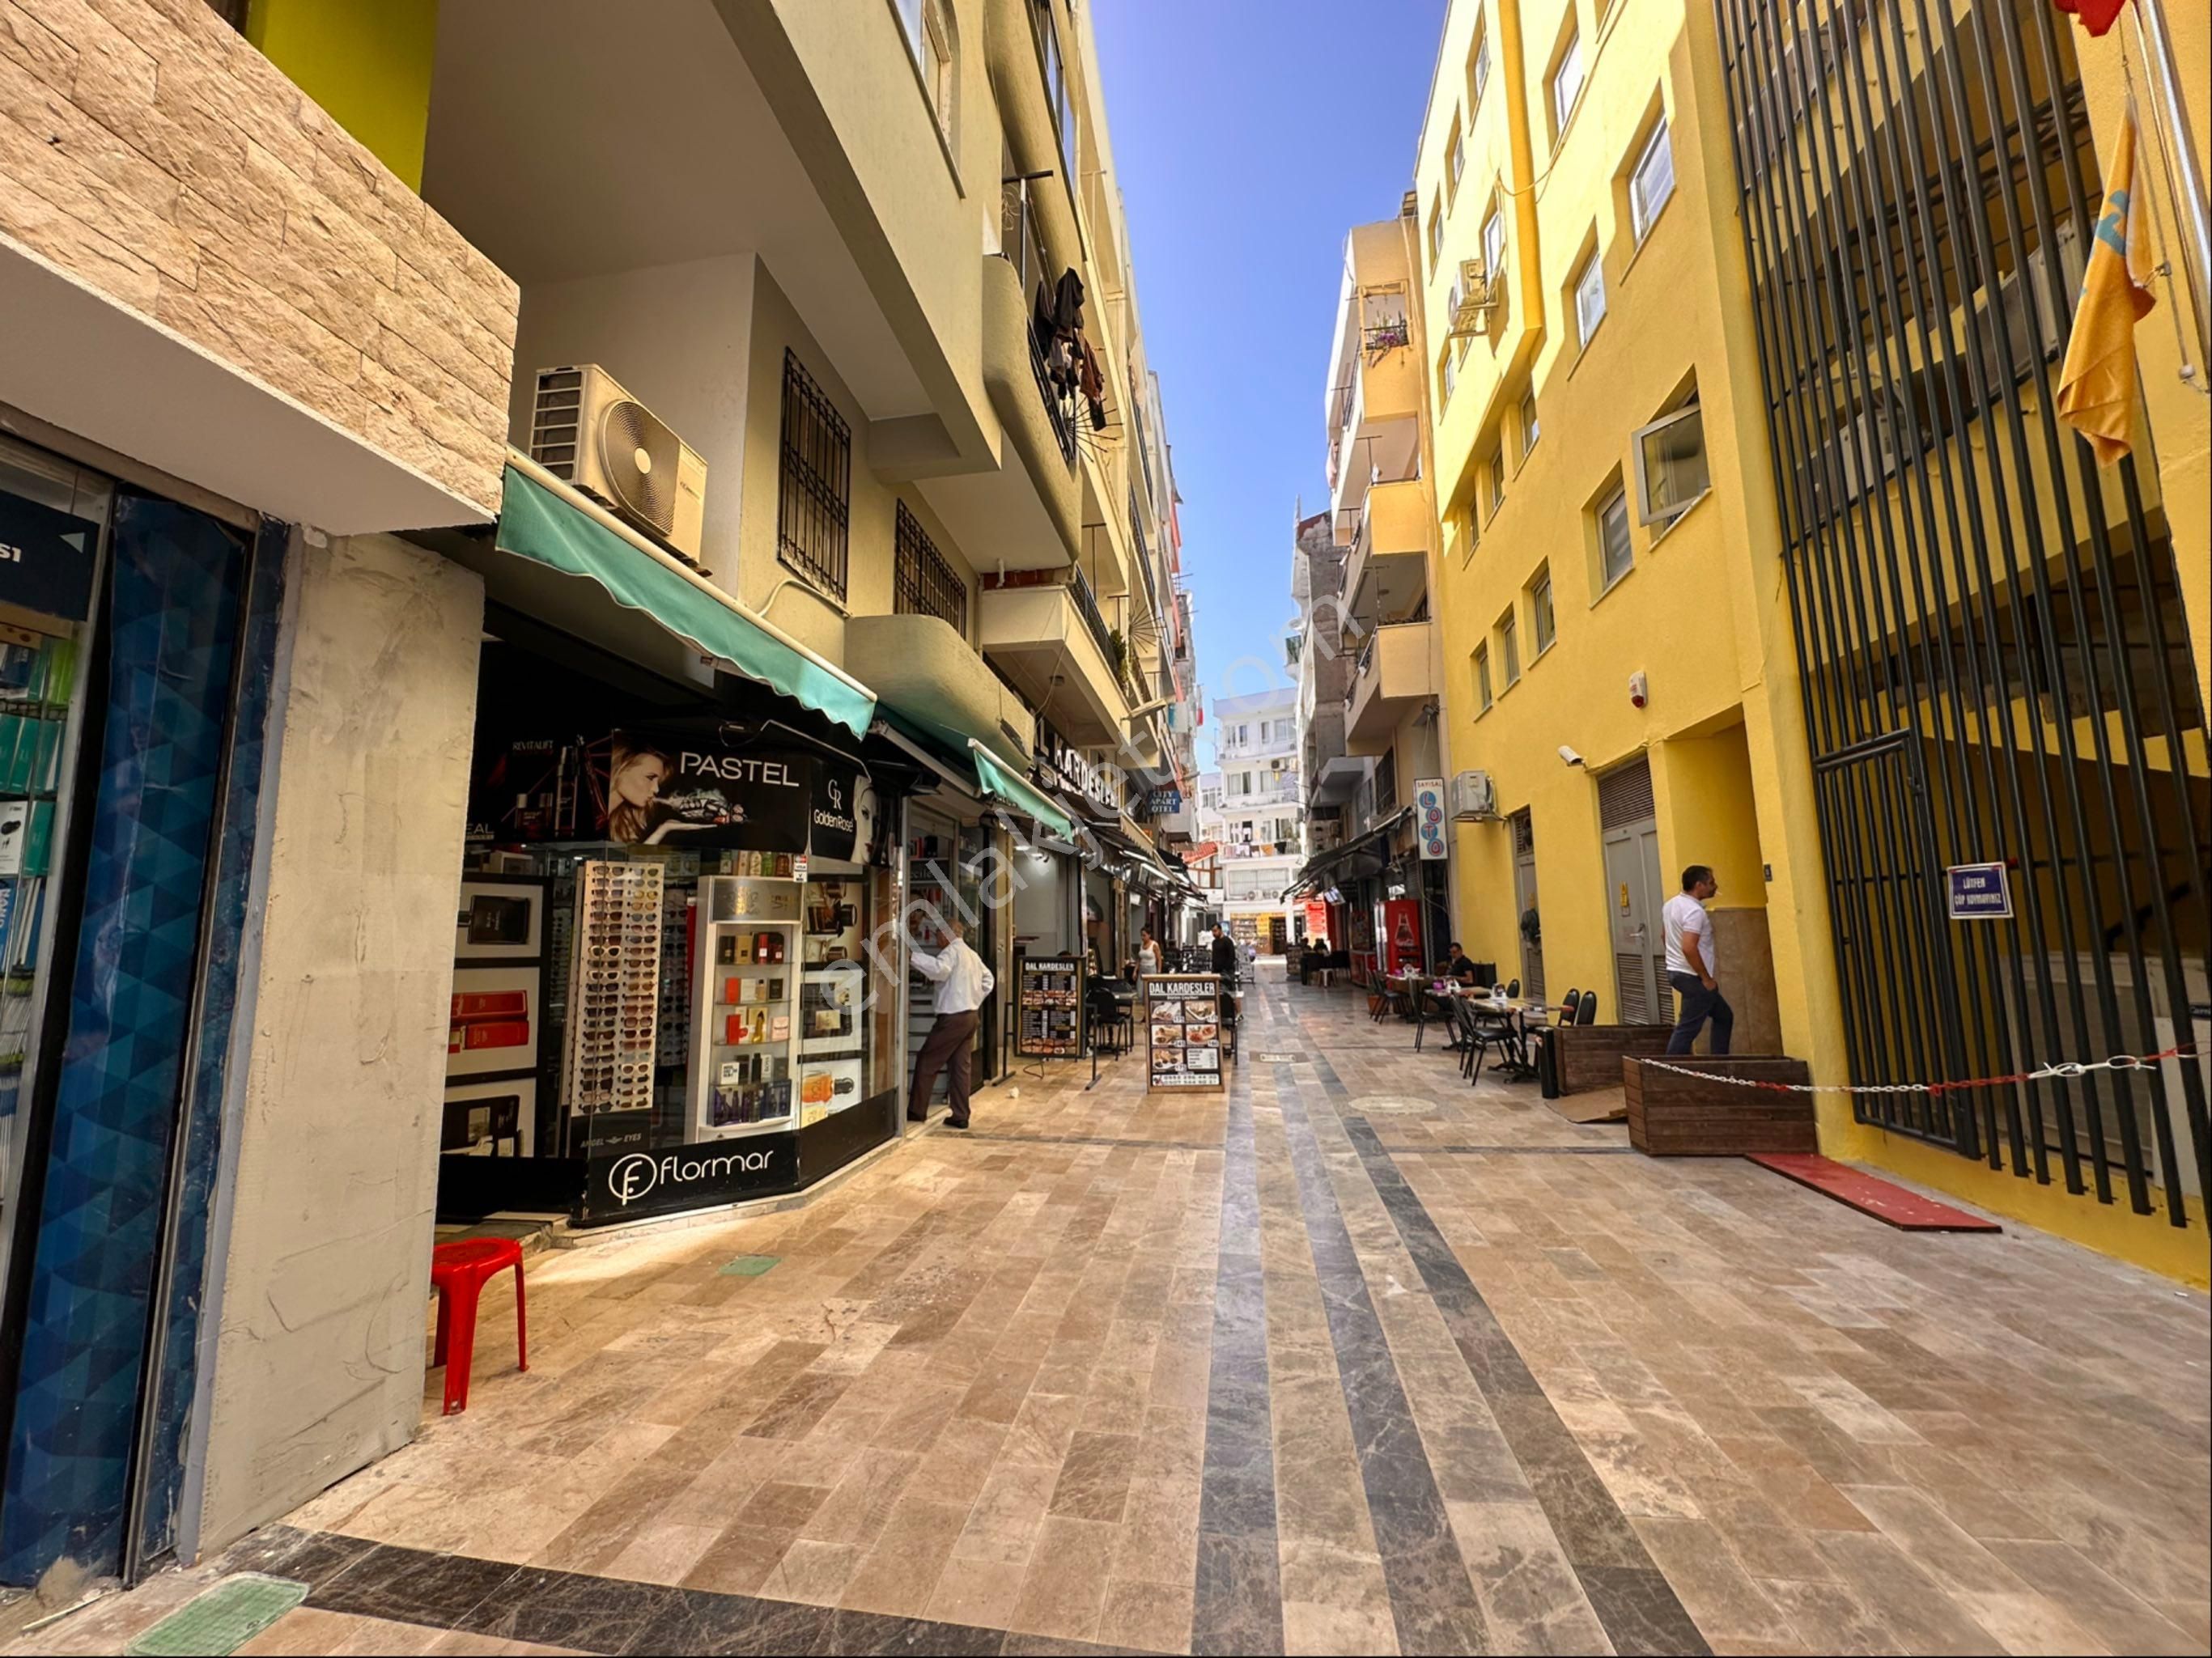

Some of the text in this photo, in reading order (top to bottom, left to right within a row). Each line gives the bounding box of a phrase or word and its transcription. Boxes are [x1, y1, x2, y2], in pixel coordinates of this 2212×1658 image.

[680, 751, 800, 787] PASTEL
[1151, 805, 1173, 813] OTEL
[1963, 876, 1985, 889] LÜTFEN
[1149, 982, 1165, 994] DAL
[624, 1133, 642, 1143] EYES
[660, 1150, 774, 1185] flormar
